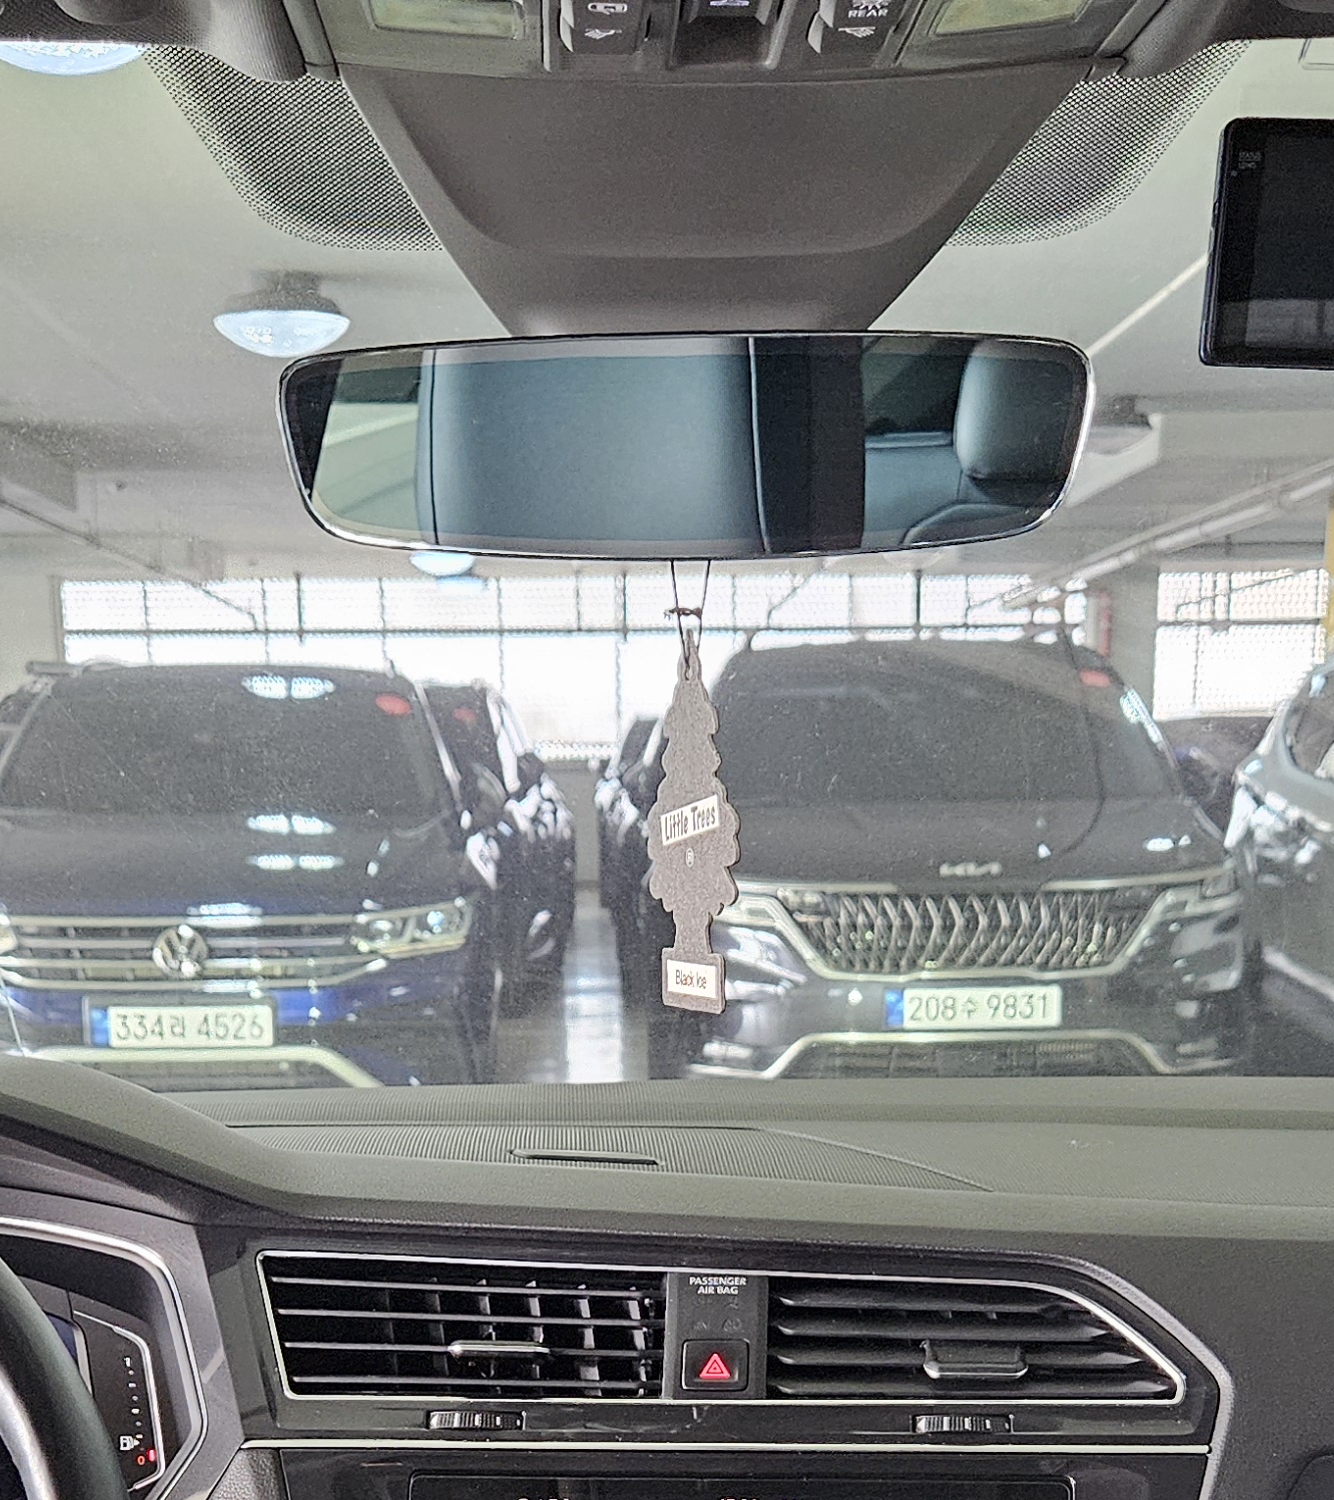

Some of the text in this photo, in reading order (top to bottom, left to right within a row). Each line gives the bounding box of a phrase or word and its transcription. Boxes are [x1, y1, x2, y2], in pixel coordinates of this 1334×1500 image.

[848, 9, 889, 18] REAR
[664, 804, 716, 843] Little Trees
[675, 969, 707, 990] Black Ice
[985, 992, 1049, 1020] 9831
[116, 1012, 265, 1041] 334라 4526
[689, 1276, 747, 1286] PASSENGER
[697, 1286, 739, 1295] AIR BAG
